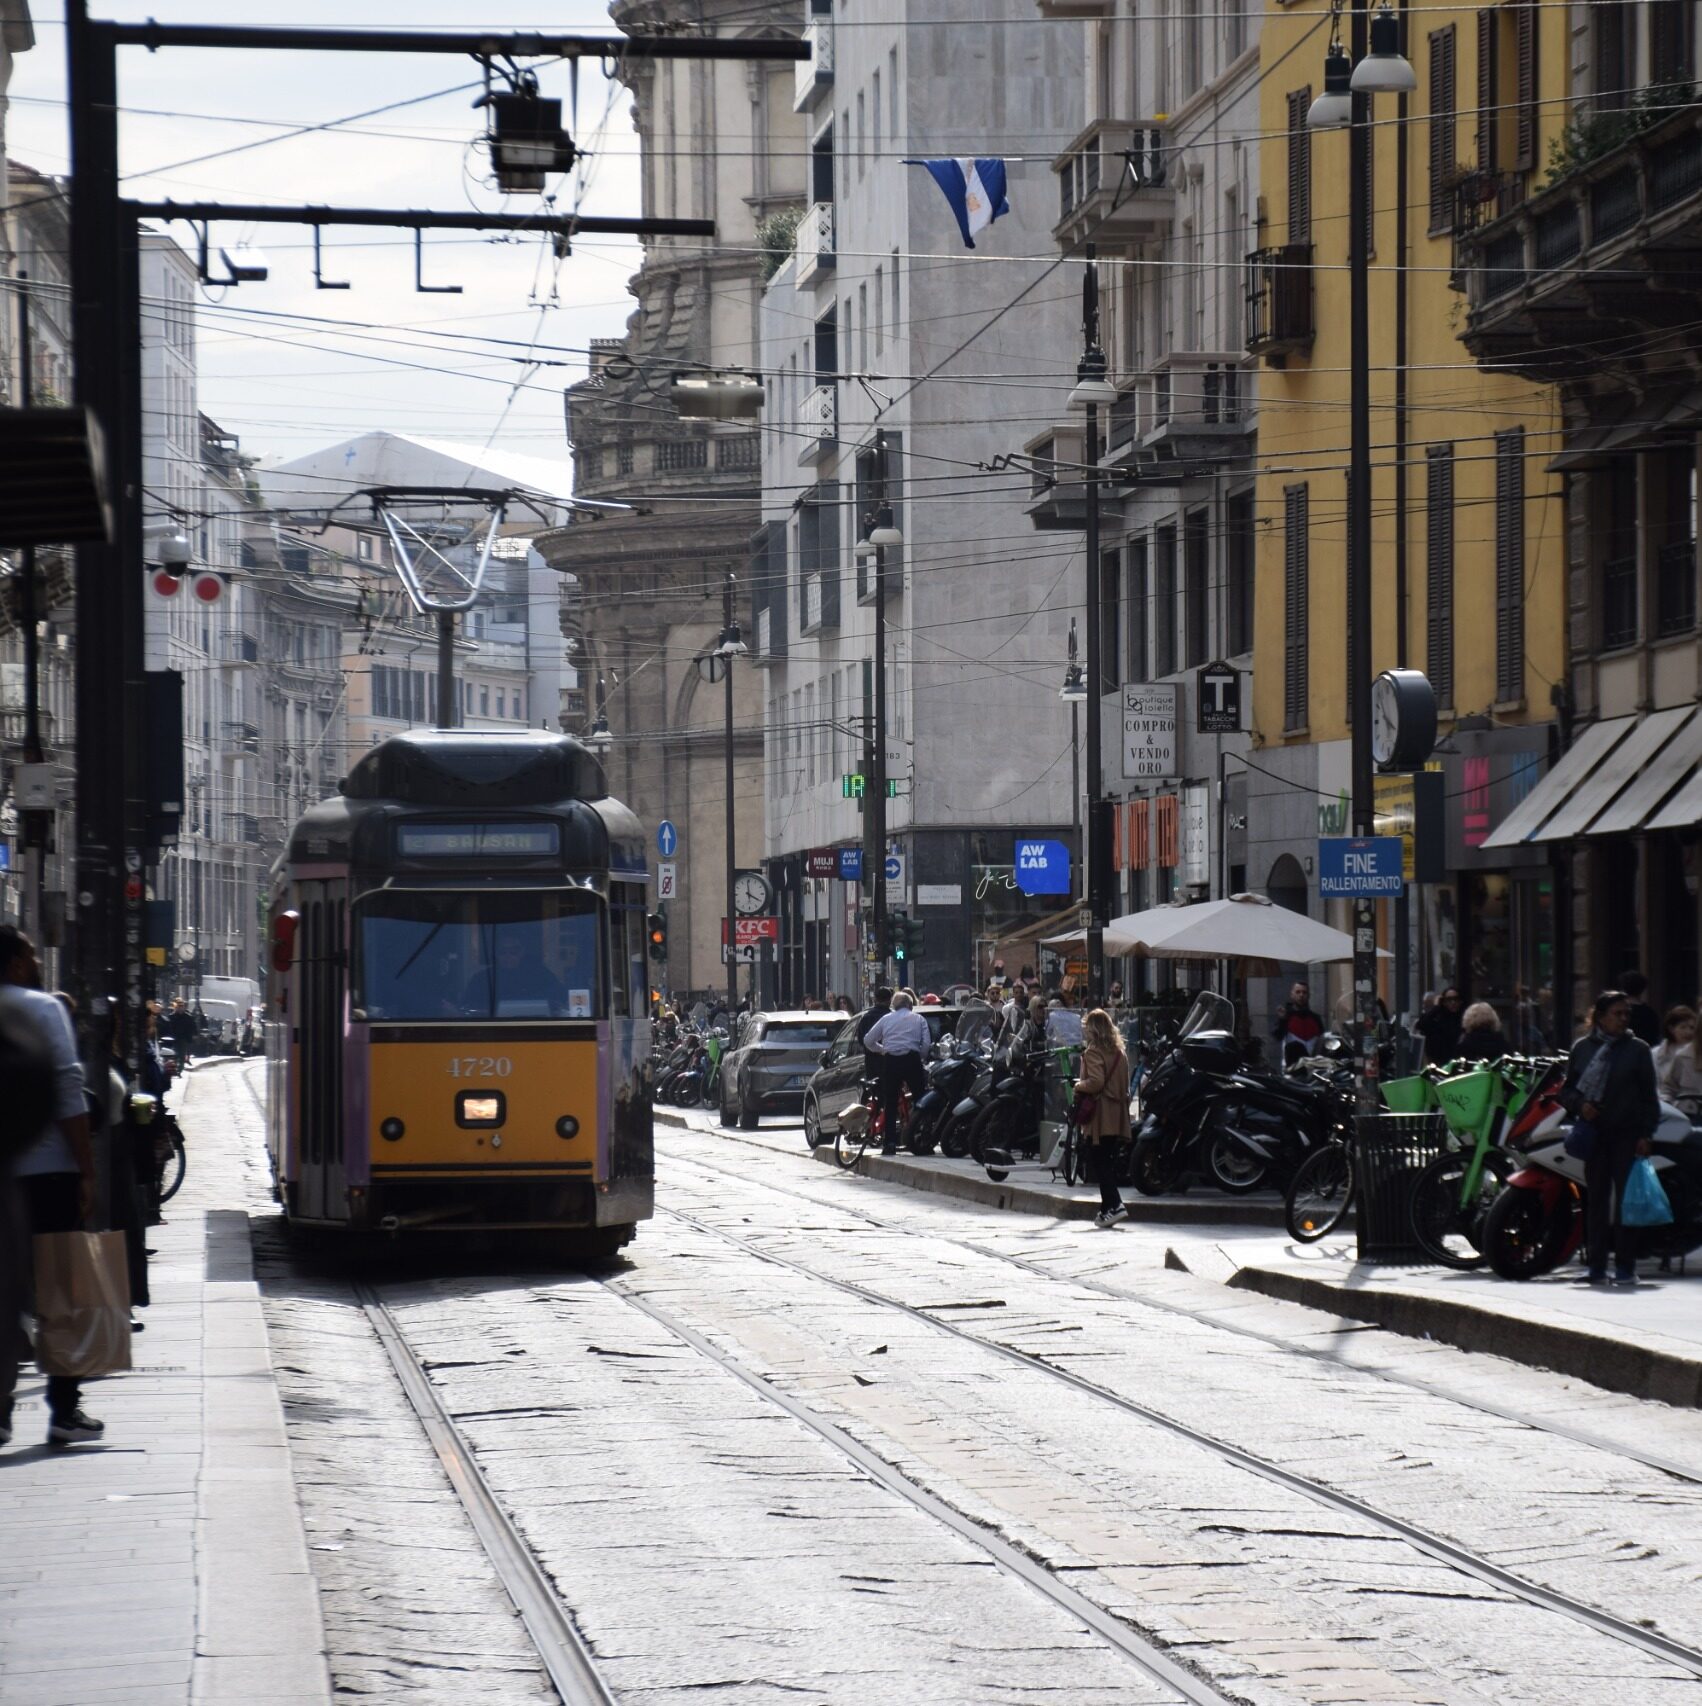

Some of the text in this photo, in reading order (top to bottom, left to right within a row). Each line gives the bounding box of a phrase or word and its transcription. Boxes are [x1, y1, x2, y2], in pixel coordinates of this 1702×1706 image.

[1204, 675, 1234, 711] T
[1125, 720, 1175, 732] COMPRO
[1146, 734, 1154, 745] &
[1130, 747, 1170, 759] VENDO
[1138, 762, 1162, 774] ORO
[1020, 844, 1045, 856] AW
[813, 856, 834, 866] MUJI
[1020, 857, 1048, 869] LAB
[1344, 853, 1378, 874] FINE
[1321, 875, 1401, 891] RALLENTAMENTO
[736, 919, 770, 934] KFC
[446, 1056, 513, 1077] 4720
